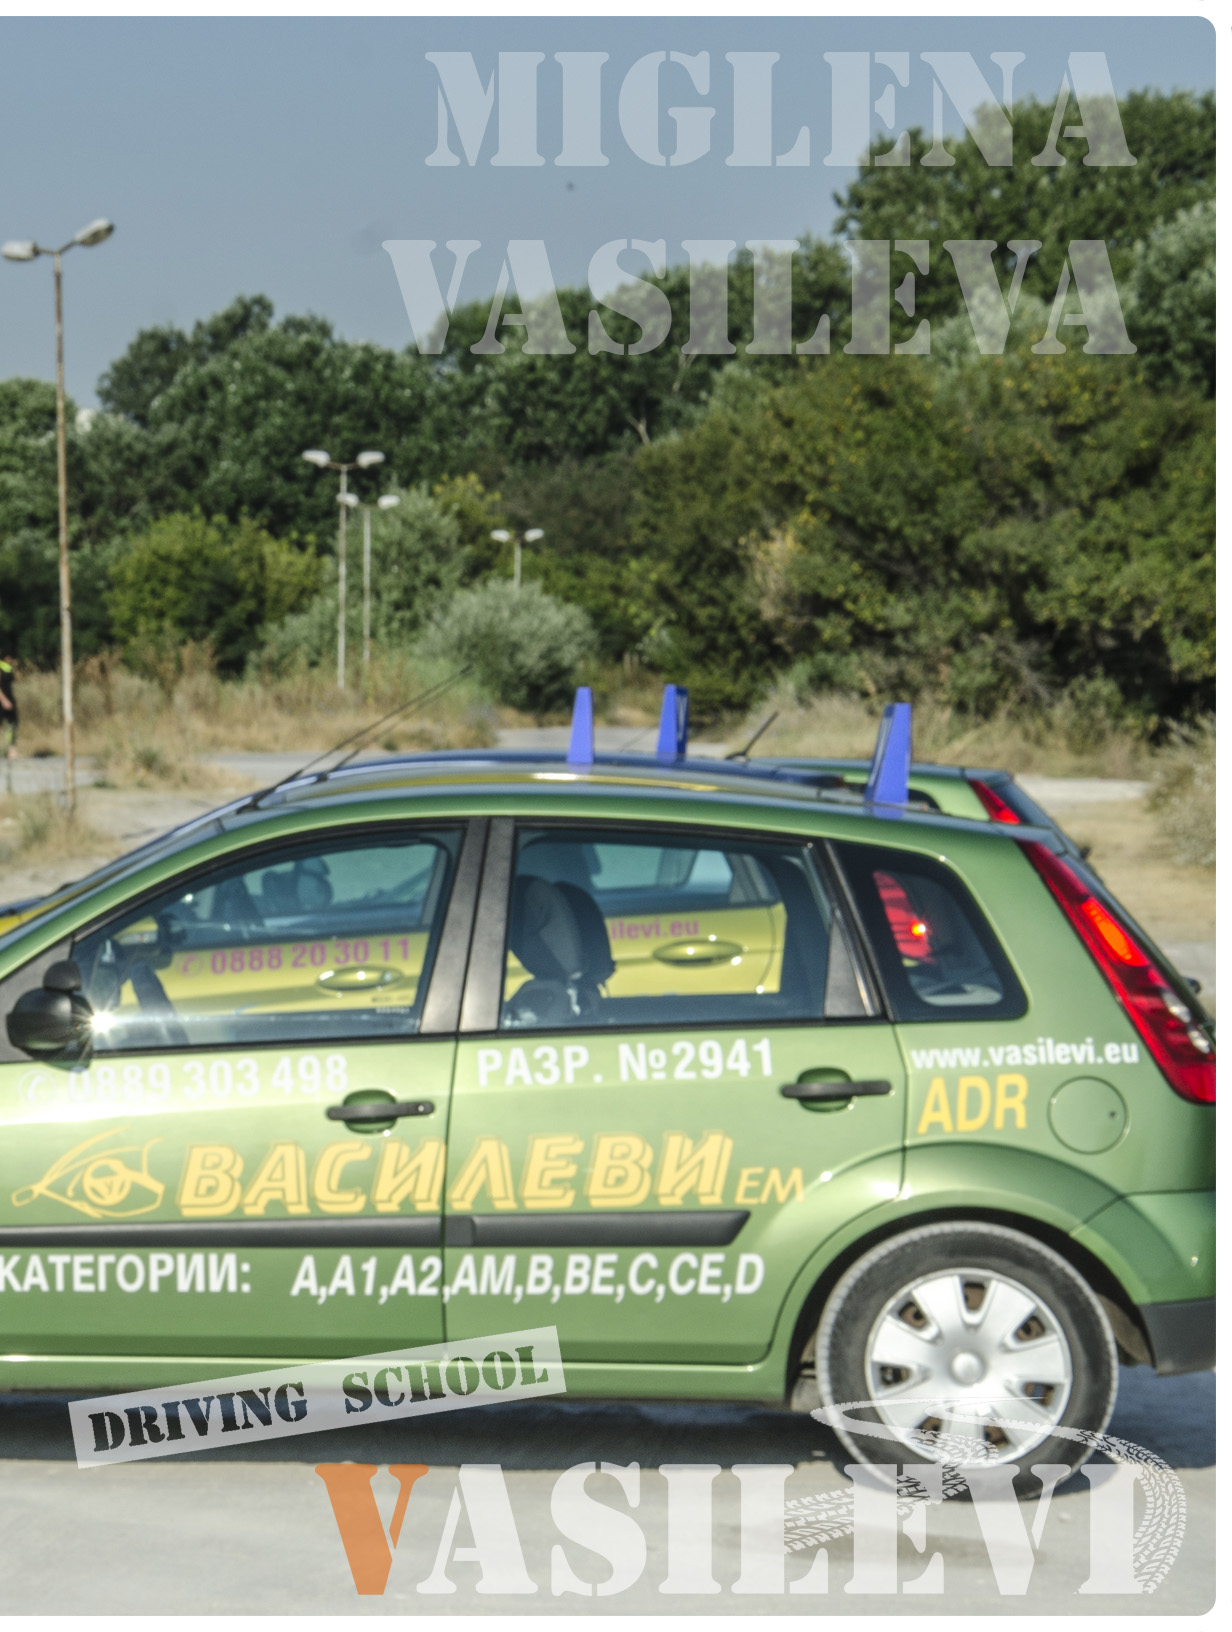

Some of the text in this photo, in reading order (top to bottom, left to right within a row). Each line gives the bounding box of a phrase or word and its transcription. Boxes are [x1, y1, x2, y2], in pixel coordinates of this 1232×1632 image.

[210, 938, 410, 975] 0888 20 30 11
[477, 1045, 603, 1087] РАЗР.
[910, 1037, 1140, 1069] www.vasilevi.eu
[68, 1053, 348, 1101] 0889 303 498
[917, 1073, 1029, 1134] ADR
[177, 1130, 735, 1217] ВАСИЛЕВИ
